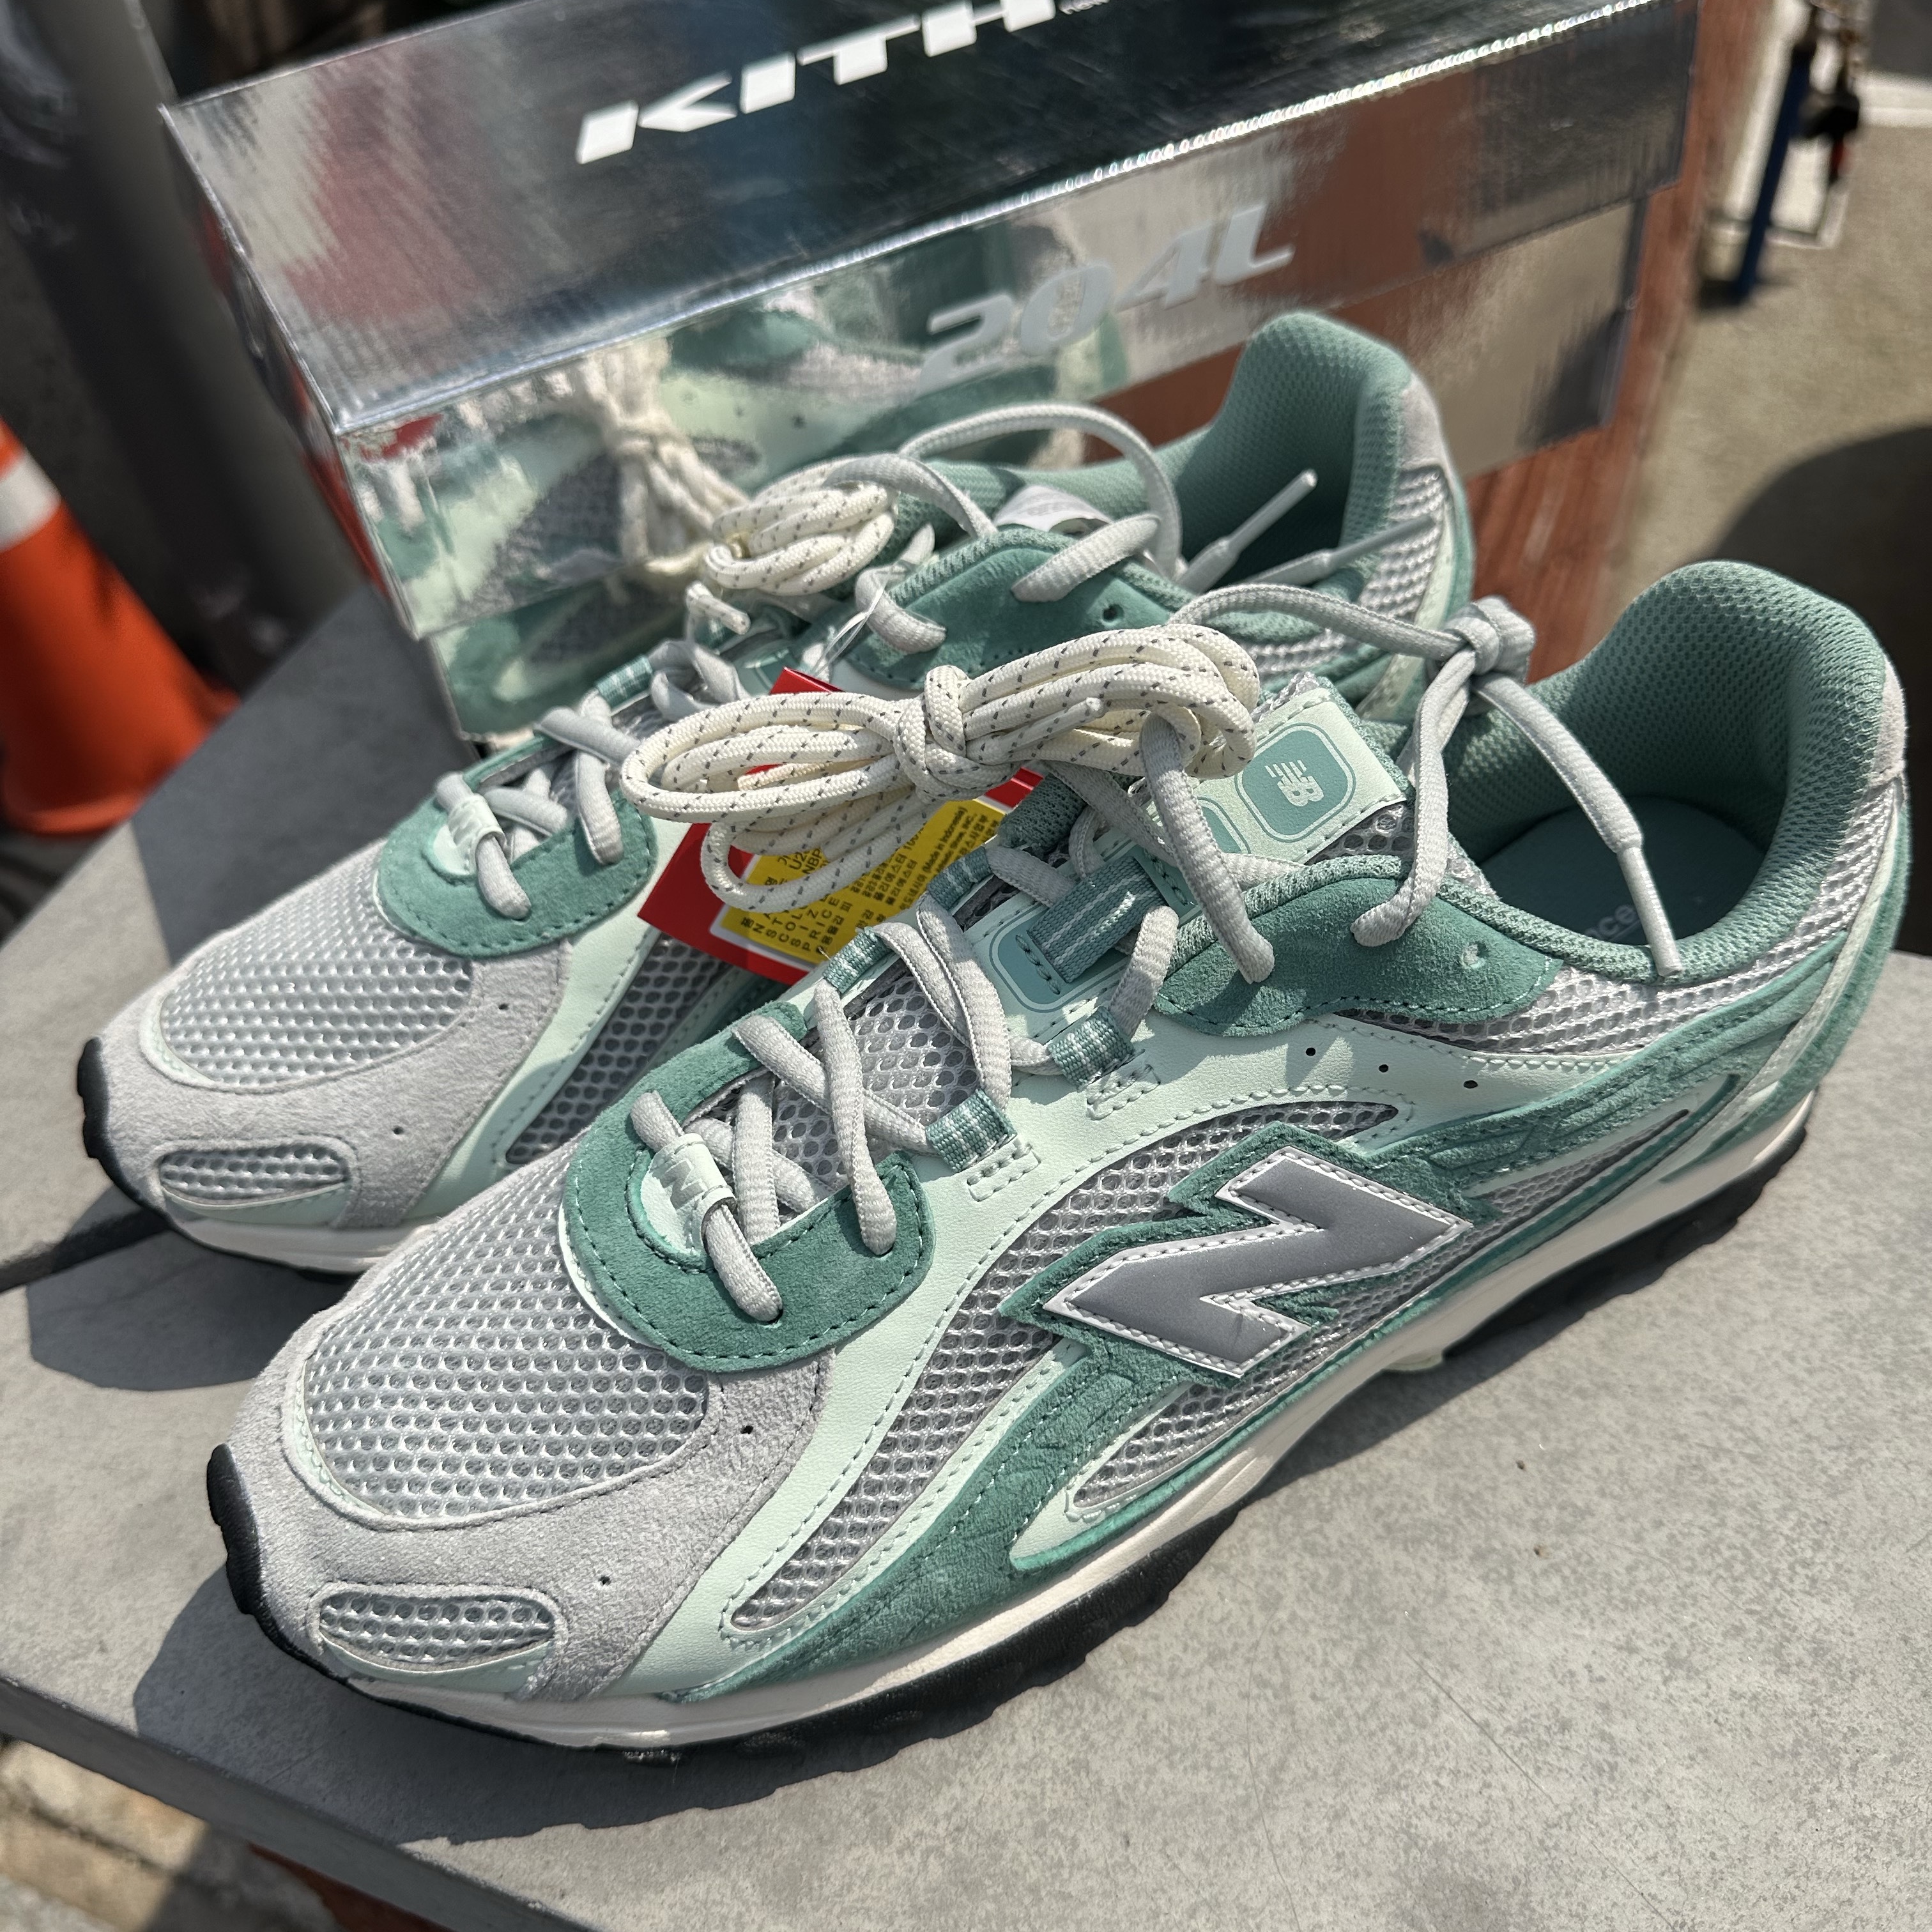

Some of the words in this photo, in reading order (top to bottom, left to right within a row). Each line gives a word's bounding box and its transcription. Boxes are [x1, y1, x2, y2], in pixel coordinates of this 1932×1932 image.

[576, 0, 1055, 164] KITH
[918, 203, 1295, 400] 204L
[802, 898, 839, 951] PRICE
